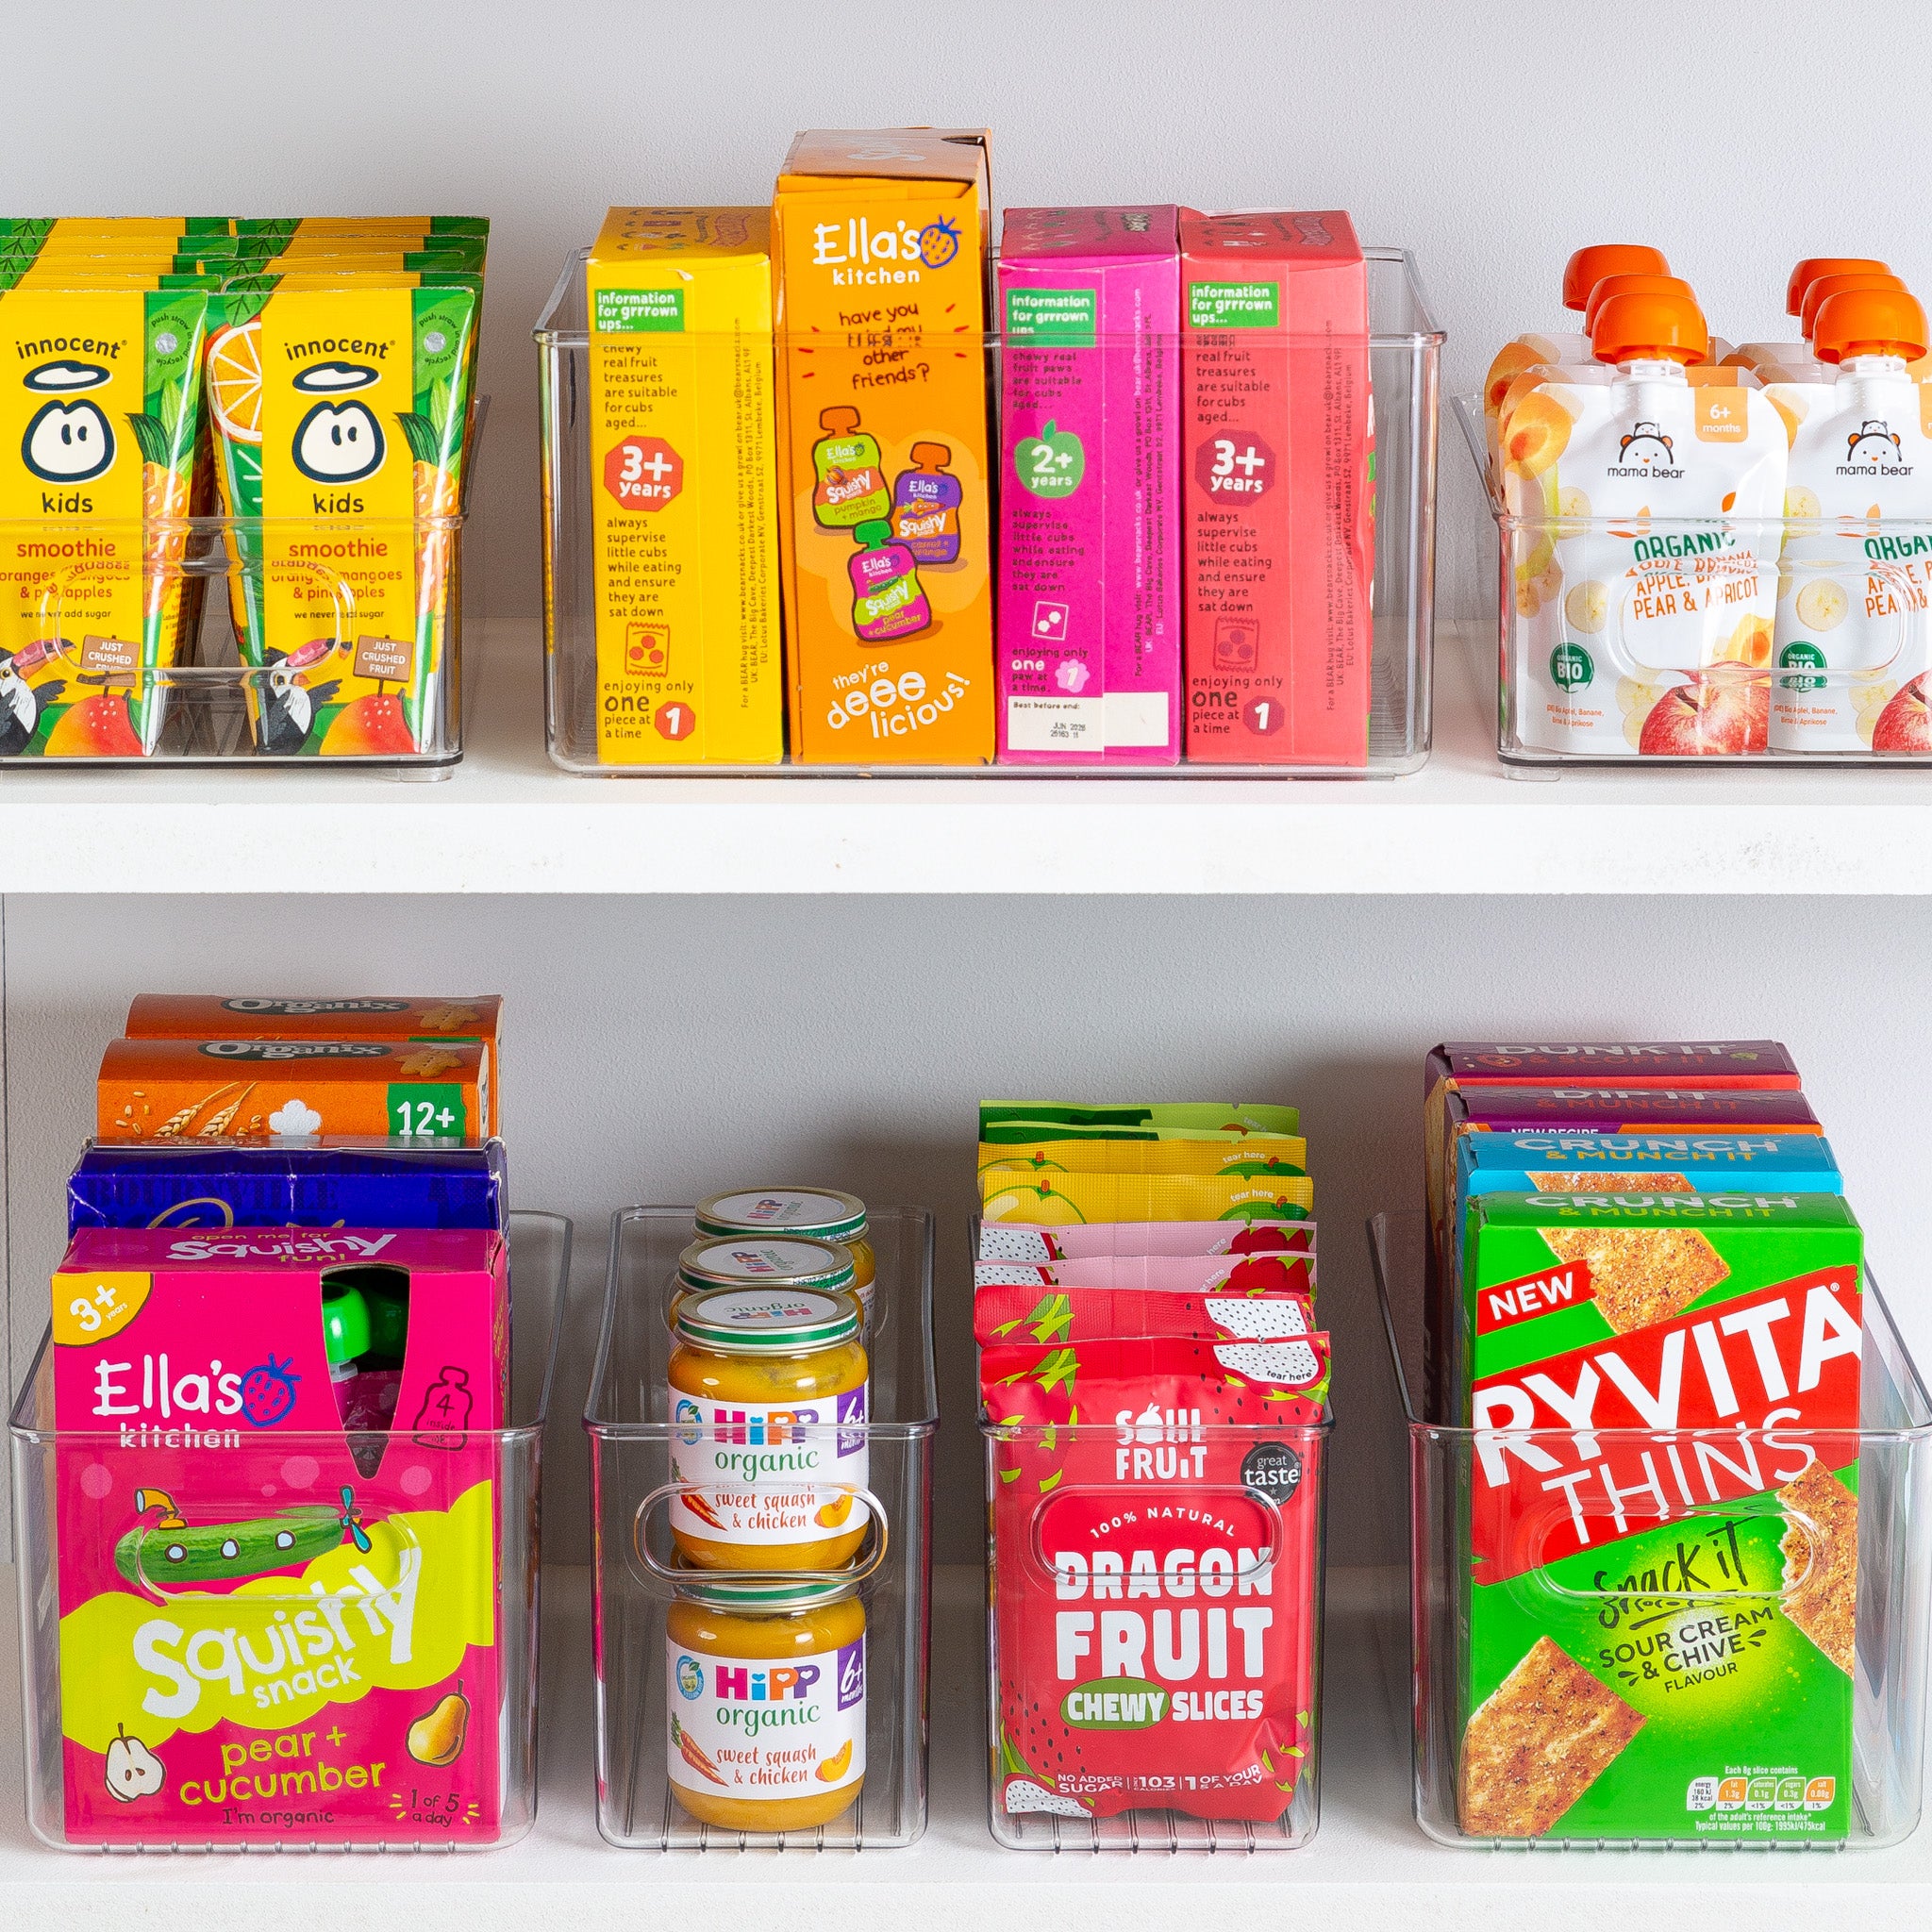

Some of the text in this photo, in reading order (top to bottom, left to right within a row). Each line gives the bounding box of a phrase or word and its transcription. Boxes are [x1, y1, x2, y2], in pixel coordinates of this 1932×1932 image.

[812, 216, 921, 265] Ella's
[833, 268, 920, 286] kitchen
[598, 291, 675, 305] information
[1191, 286, 1270, 297] information
[1012, 295, 1090, 308] information
[1192, 299, 1272, 312] for grrrown
[598, 305, 677, 320] for grrrown
[840, 303, 919, 326] have you
[1012, 310, 1089, 324] for grrrown
[419, 313, 458, 366] push straw recycle
[604, 357, 658, 368] real fruit
[863, 348, 908, 366] other
[604, 372, 662, 383] treasures
[852, 362, 930, 390] friends?
[605, 386, 677, 398] are suitable
[605, 402, 653, 413] for cubs
[1709, 404, 1730, 419] 6+
[1703, 423, 1740, 433] months
[619, 444, 673, 481] 3+
[1031, 444, 1073, 474] 2+
[1211, 439, 1265, 476] 3+
[1607, 466, 1685, 478] mama bear
[1836, 464, 1913, 476] mama bear
[619, 481, 671, 498] years
[826, 470, 871, 504] Squishy
[1031, 475, 1073, 488] years
[1211, 475, 1263, 493] years
[42, 491, 93, 513] kids
[313, 493, 364, 513] kids
[834, 497, 876, 515] pumpkin
[607, 518, 648, 530] always
[900, 513, 946, 537] Squishy
[607, 532, 666, 545] supervise
[17, 538, 116, 558] smoothie
[289, 538, 388, 558] smoothie
[607, 547, 667, 558] little cubs
[340, 570, 402, 583] mangoes
[608, 562, 682, 575] while eating
[359, 611, 384, 620] sugar
[1633, 597, 1676, 620] PEAR
[373, 641, 396, 651] JUST
[362, 652, 406, 664] CRUSHED
[369, 663, 396, 675] FRUIT
[832, 661, 889, 690] they're
[1011, 659, 1078, 686] one 1
[1557, 662, 1582, 680] BIO
[604, 680, 693, 693] enjoying only
[604, 694, 650, 712] one
[827, 671, 926, 729] deee
[870, 672, 971, 739] licious!
[1191, 691, 1238, 708] one
[665, 707, 681, 736] 1
[1255, 703, 1269, 729] 1
[227, 997, 396, 1014] Organix
[204, 1041, 377, 1058] Organix
[1495, 1045, 1724, 1056] DUNK IT
[396, 1102, 455, 1136] 12+
[1513, 1138, 1776, 1152] CRUNCH
[1579, 1152, 1757, 1160] MUNCH IT
[1230, 1190, 1274, 1202] tear here
[1524, 1196, 1797, 1208] CRUNCH
[1591, 1208, 1774, 1217] MUNCH IT
[166, 1233, 396, 1259] Squishy
[279, 1252, 346, 1262] fun!
[1489, 1272, 1574, 1321] NEW
[70, 1285, 116, 1332] 3+
[106, 1302, 128, 1322] years
[1266, 1371, 1312, 1381] tear here
[92, 1353, 242, 1418] Ella's
[436, 1393, 455, 1417] 4
[120, 1423, 240, 1448] kitchen
[714, 1445, 819, 1482] organic
[1257, 1455, 1288, 1468] great
[1541, 1407, 1817, 1545] THINS
[1091, 1507, 1235, 1539] 100% NATURAL
[1055, 1547, 1273, 1600] DRAGON
[133, 1546, 422, 1718] Squishy
[1600, 1607, 1774, 1668] SOUR CREAM
[1055, 1607, 1274, 1680] FRUIT
[1643, 1634, 1745, 1680] & CHIVE
[841, 1650, 863, 1694] 6+
[1664, 1662, 1739, 1693] FLAVOUR
[254, 1657, 361, 1708] snack
[715, 1664, 821, 1701] HiPP
[1067, 1690, 1263, 1723] CHEWY SLICES
[716, 1701, 821, 1737] organic
[221, 1730, 317, 1775] pear
[716, 1743, 817, 1769] sweet squash
[749, 1767, 808, 1786] chicken
[1058, 1774, 1123, 1783] NO ADDED
[1185, 1764, 1261, 1790] 1 YOUR
[1724, 1766, 1742, 1774] Each
[1770, 1766, 1798, 1774] contains
[180, 1760, 387, 1807] cucumber
[1059, 1782, 1123, 1794] SUGAR
[1138, 1775, 1175, 1789] 103
[410, 1790, 461, 1812] 1 of 5
[223, 1807, 334, 1827] I'm organic
[412, 1811, 454, 1828] a day
